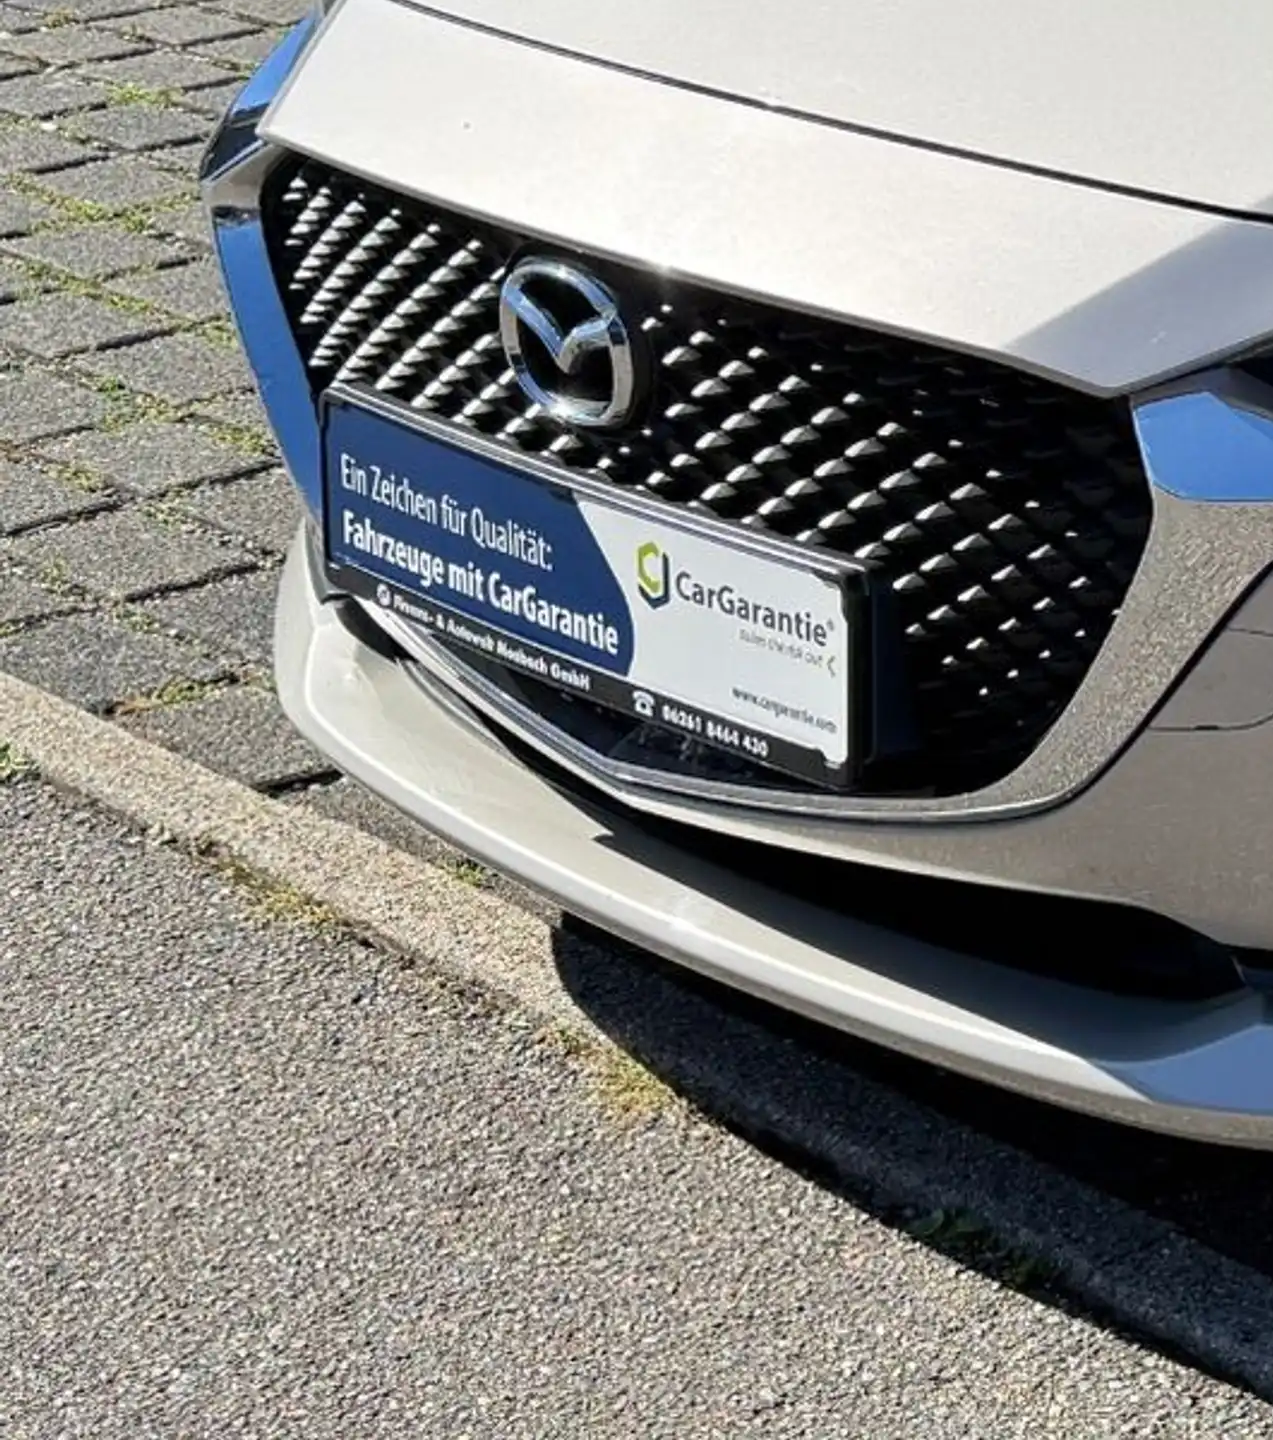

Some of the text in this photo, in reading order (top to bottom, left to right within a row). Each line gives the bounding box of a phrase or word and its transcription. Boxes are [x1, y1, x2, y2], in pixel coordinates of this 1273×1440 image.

[341, 454, 553, 571] Ein Zeichen für Qualität:
[343, 509, 620, 656] Fahrzeuge mit CarGarantie
[675, 569, 828, 647] CarGarantie
[550, 663, 591, 691] GmbH
